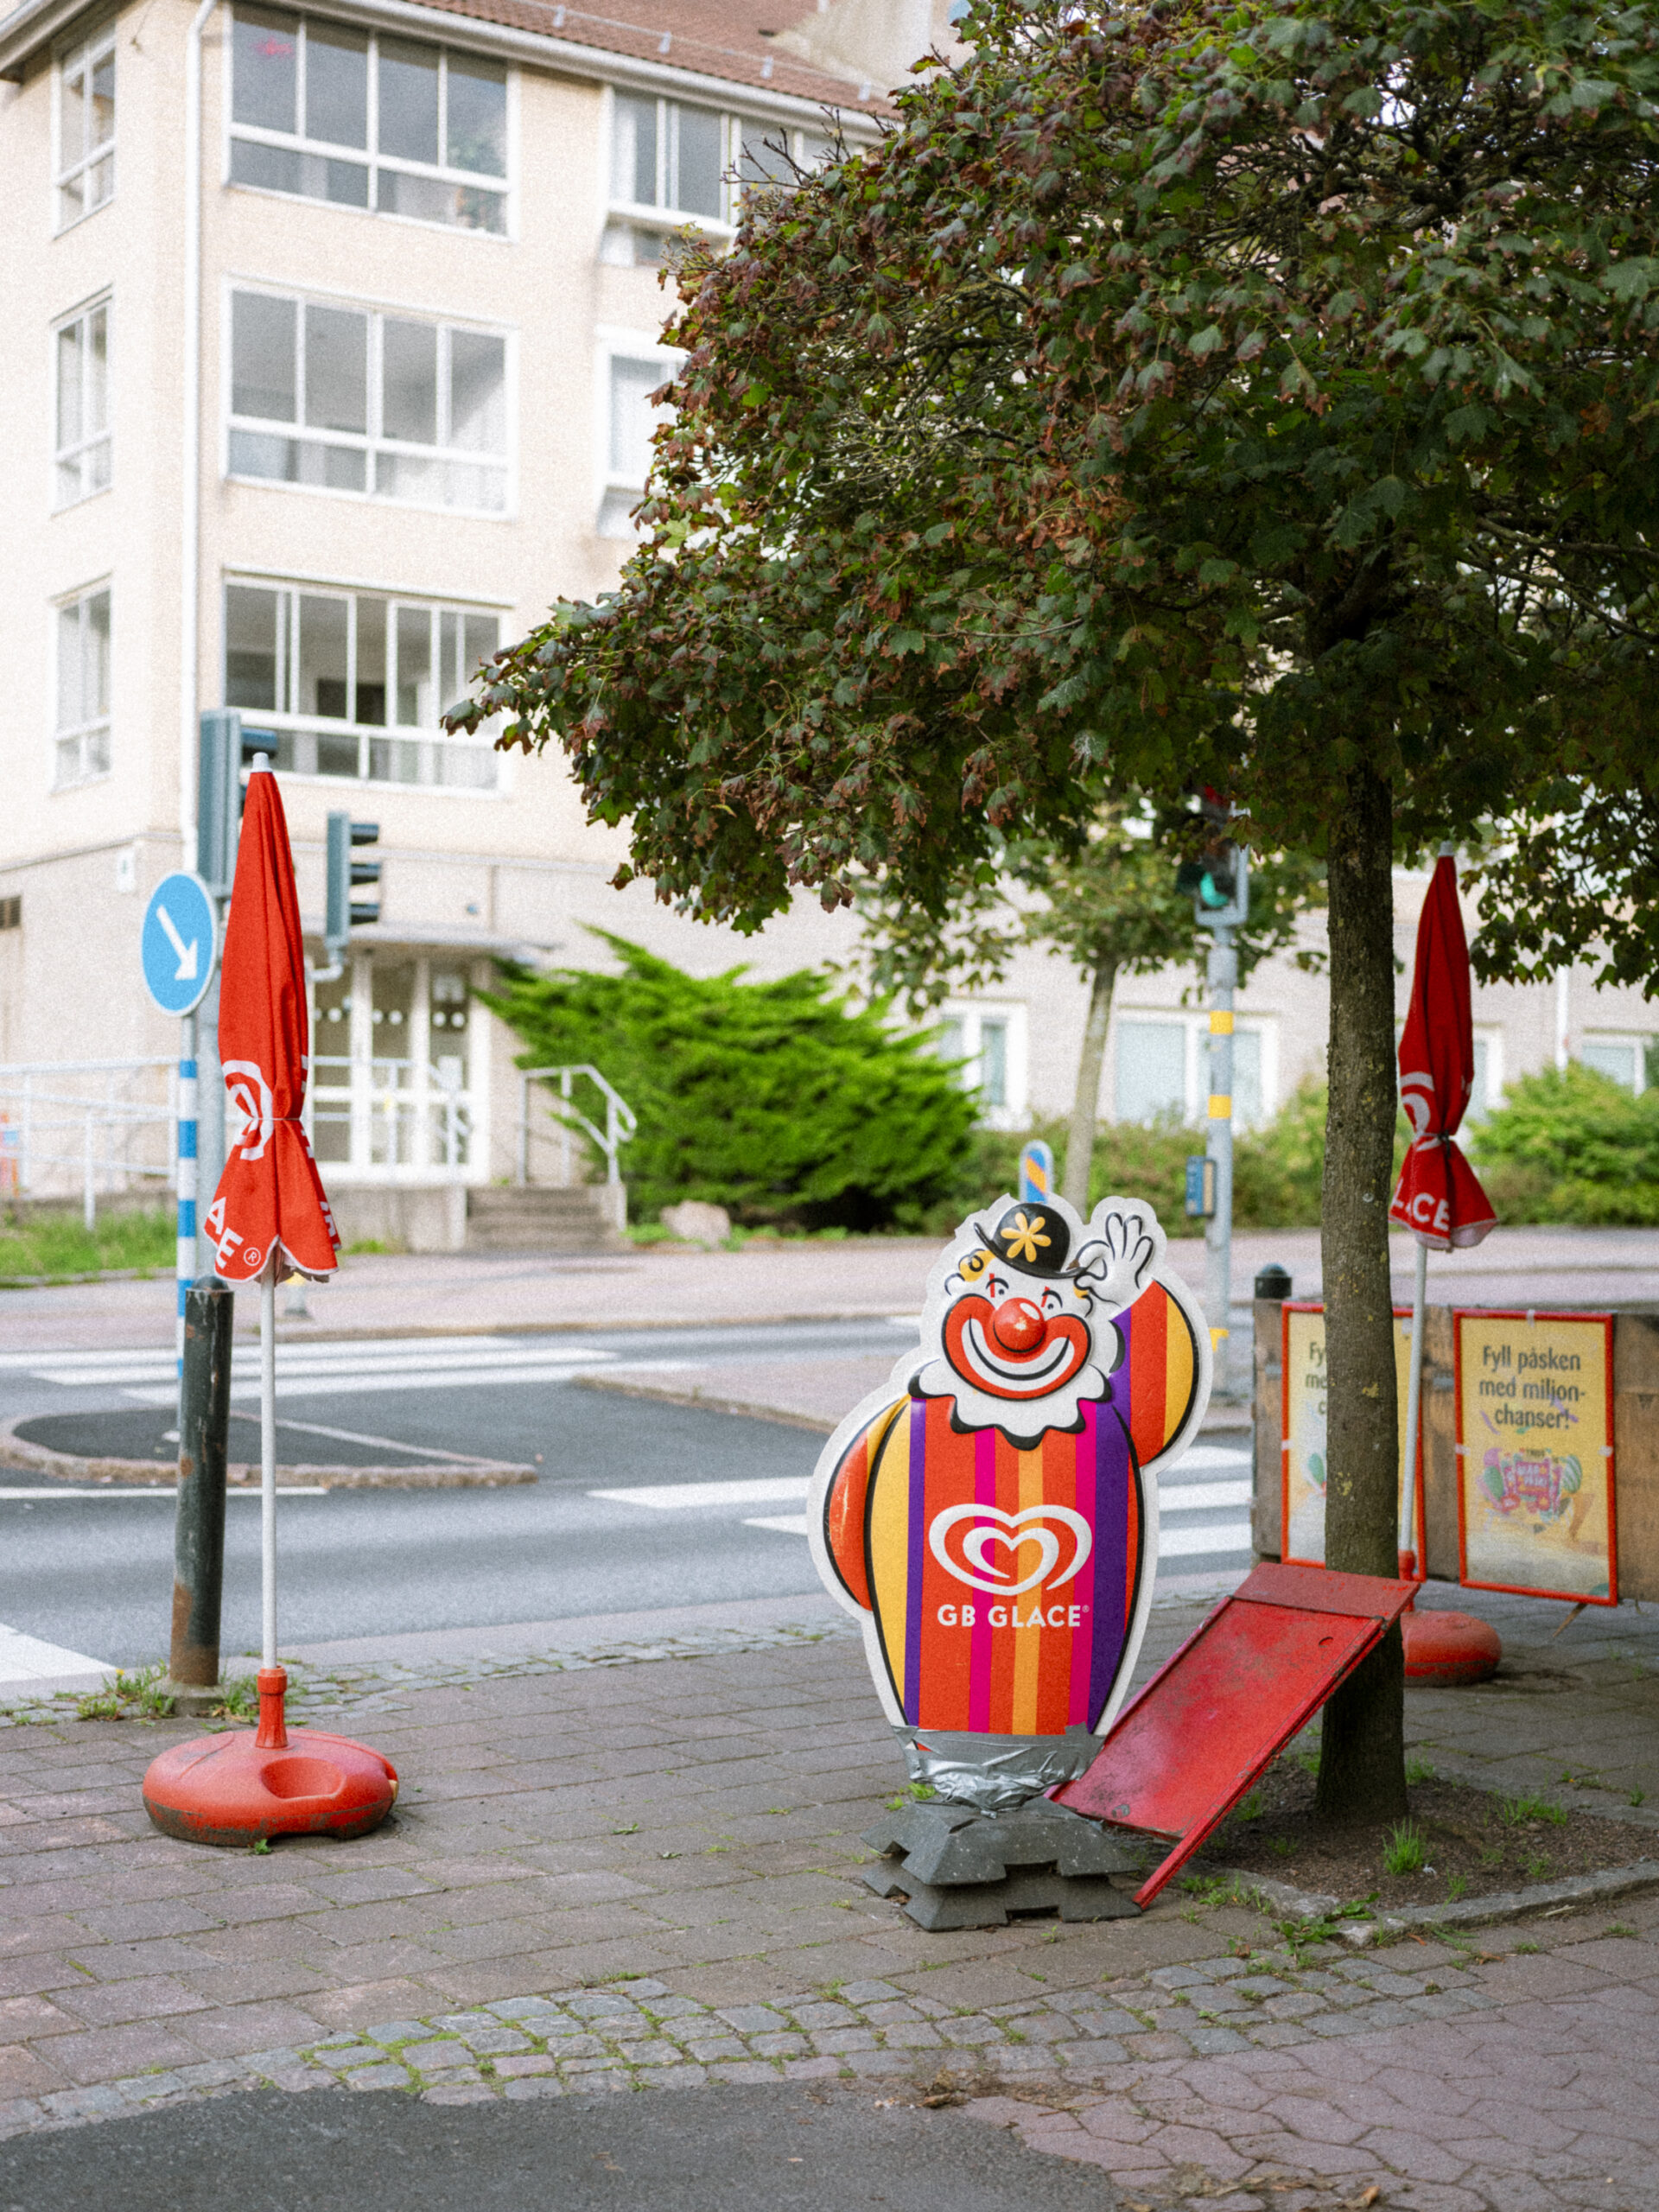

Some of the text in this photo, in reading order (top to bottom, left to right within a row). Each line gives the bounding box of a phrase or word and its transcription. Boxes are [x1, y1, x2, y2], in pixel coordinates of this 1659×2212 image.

[1309, 1341, 1326, 1367] Fy
[1483, 1345, 1581, 1375] Fyll påsken
[1306, 1374, 1328, 1390] me
[1479, 1376, 1586, 1408] med miljon-
[1494, 1402, 1569, 1429] chanser!
[937, 1604, 976, 1627] GB
